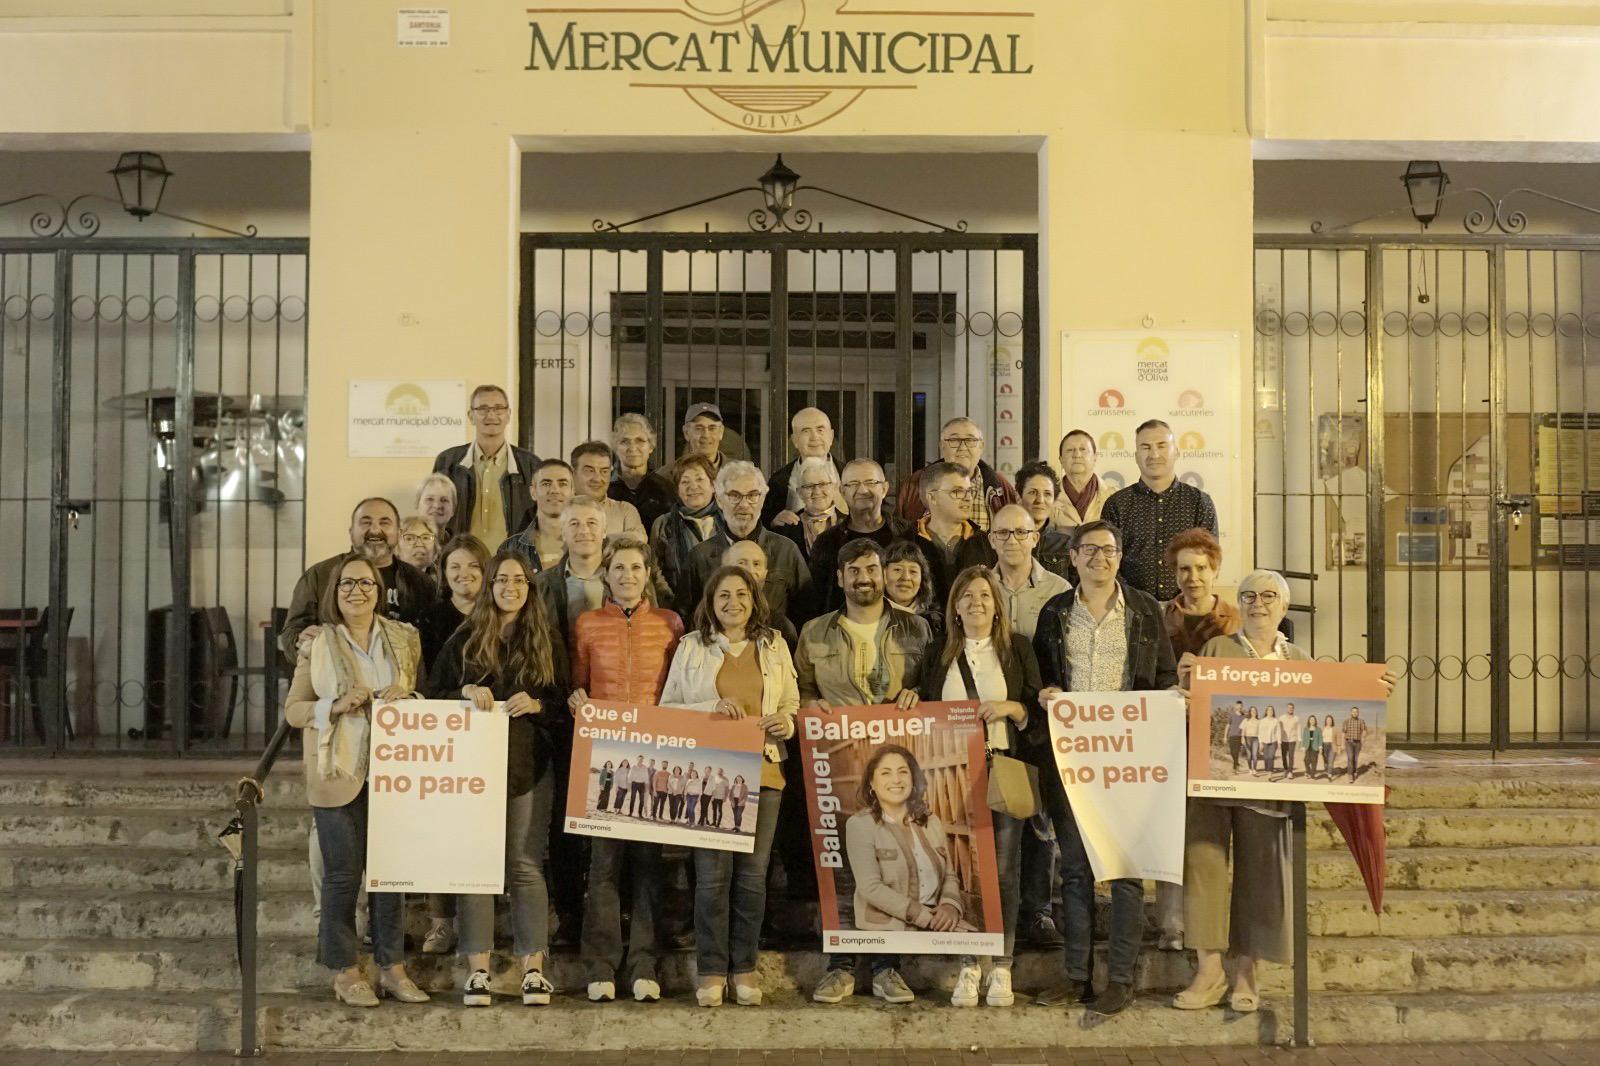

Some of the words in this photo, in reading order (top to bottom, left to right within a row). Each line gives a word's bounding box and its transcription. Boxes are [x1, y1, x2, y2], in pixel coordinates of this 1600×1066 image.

[524, 22, 741, 72] MERCAT
[747, 24, 1034, 74] MUNICIPAL
[742, 113, 803, 129] OLIVA
[533, 358, 575, 369] FERTES
[353, 417, 384, 426] mercat
[386, 416, 430, 427] municipal
[1196, 665, 1217, 681] La
[1221, 665, 1271, 687] força
[1273, 667, 1313, 687] jove
[376, 706, 438, 736] Que
[446, 707, 471, 731] el
[581, 704, 618, 722] Que
[621, 708, 638, 723] el
[1053, 699, 1115, 728] Que
[1122, 697, 1147, 721] el
[579, 726, 627, 743] canvi
[630, 731, 652, 744] no
[656, 734, 697, 750] pare
[805, 715, 936, 745] Balaguer
[1056, 728, 1134, 753] canvi
[375, 738, 454, 762] canvi
[374, 775, 412, 793] no
[420, 775, 486, 800] pare
[1061, 766, 1095, 785] no
[1103, 765, 1168, 789] pare
[812, 747, 844, 868] Balaguer
[931, 938, 945, 946] Que
